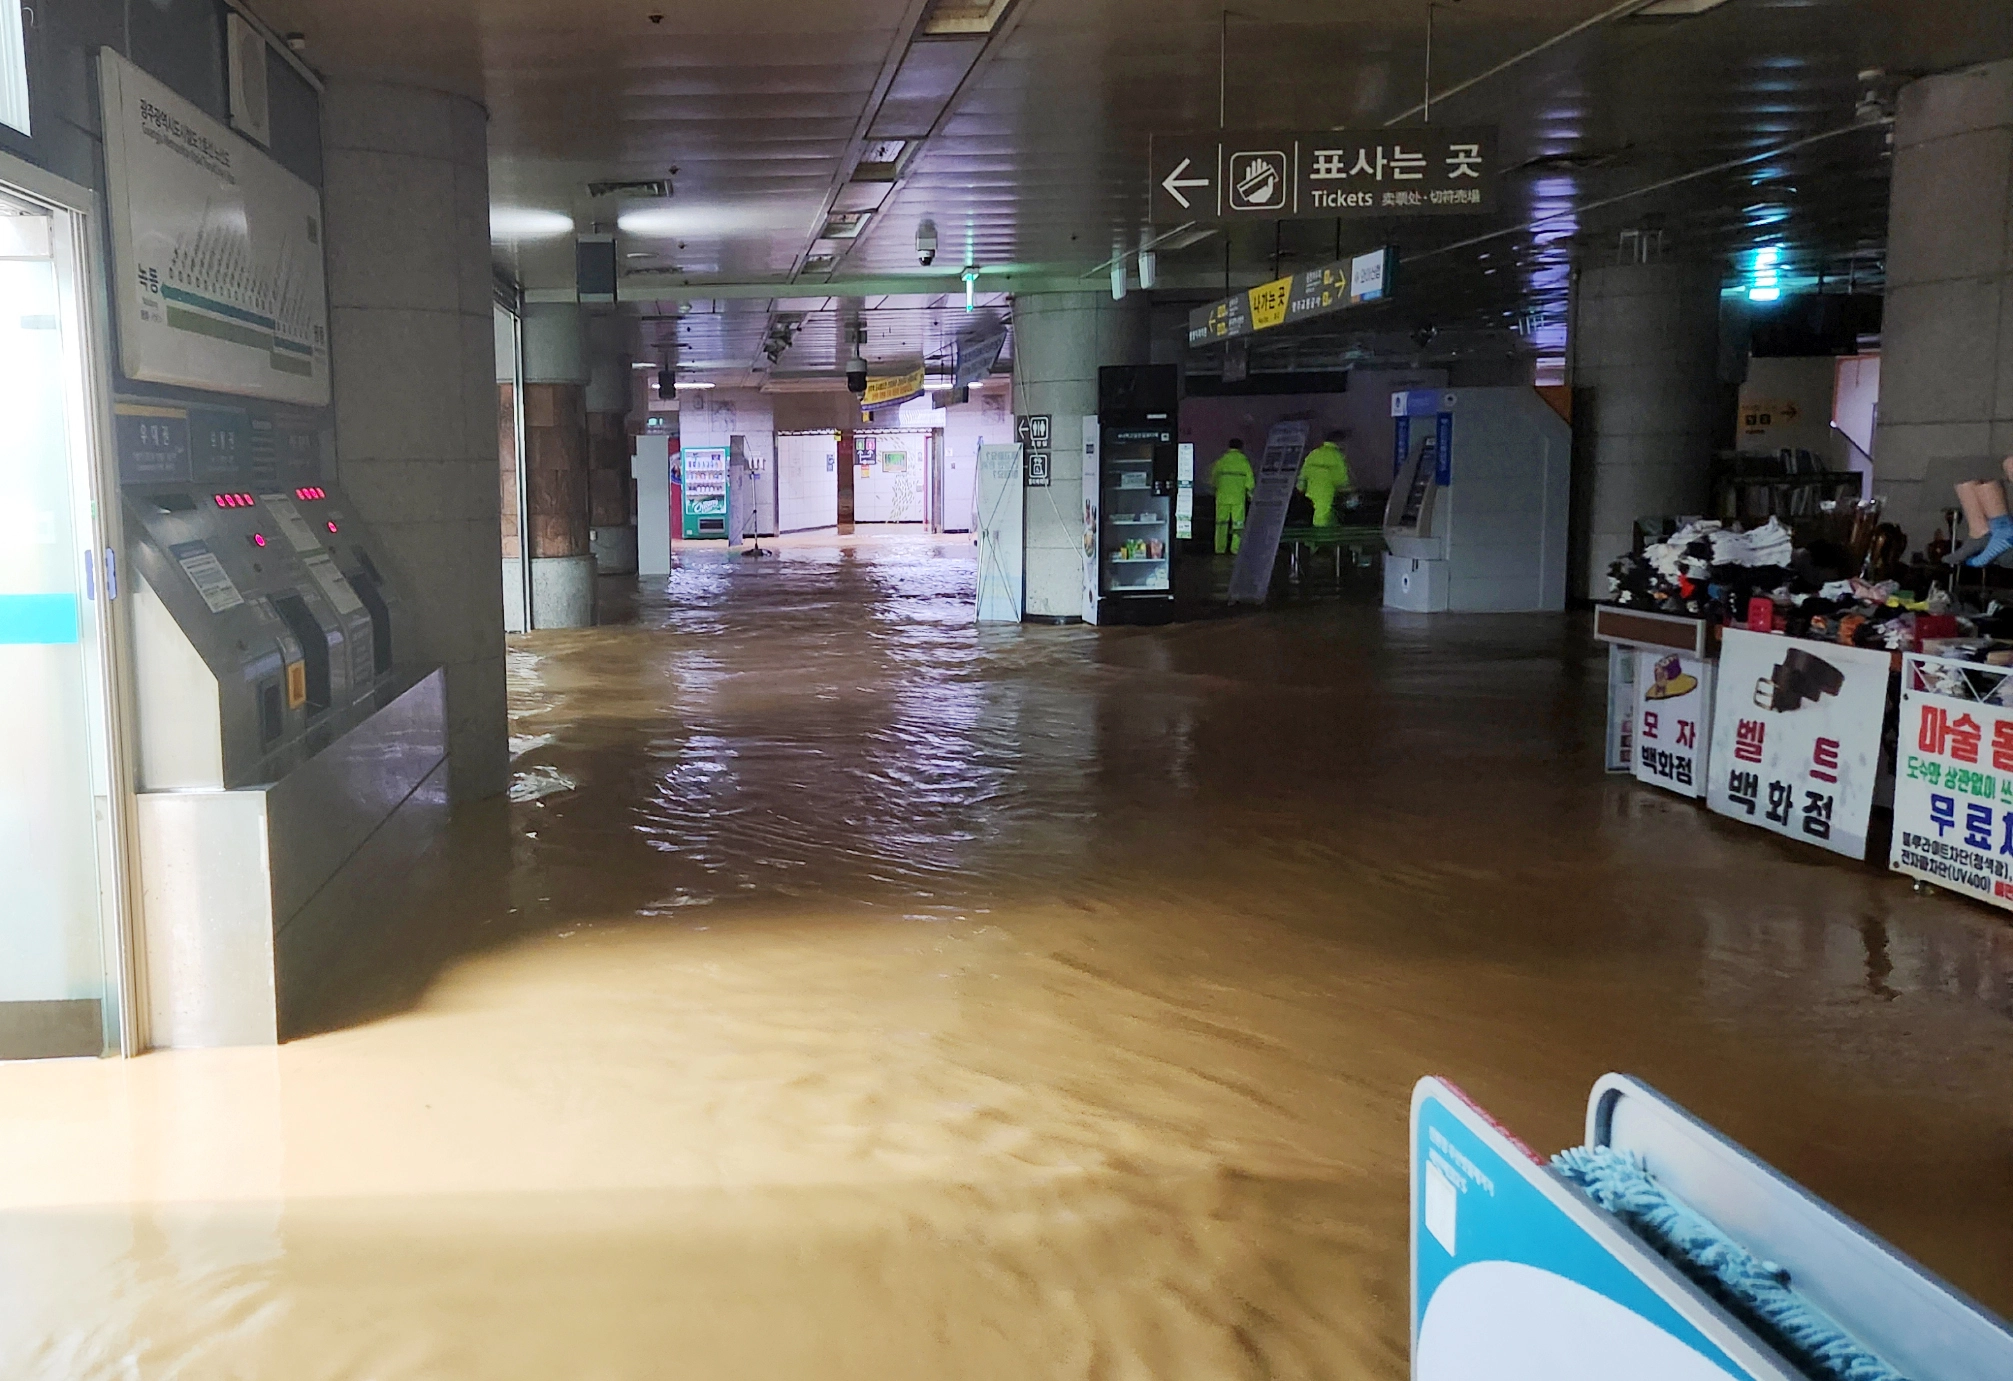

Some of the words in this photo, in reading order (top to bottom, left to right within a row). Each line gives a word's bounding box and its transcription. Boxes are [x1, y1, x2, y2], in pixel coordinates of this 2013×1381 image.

[1309, 145, 1427, 181] 표사는
[1445, 143, 1482, 179] 곳
[1310, 189, 1374, 207] Tickets
[1253, 290, 1275, 313] 나가는
[1278, 286, 1285, 307] 곳
[1643, 711, 1696, 749] 모자
[1918, 704, 1981, 764] 마술
[1642, 745, 1693, 786] 백화점
[1734, 718, 1840, 784] 벨트
[1728, 769, 1834, 841] 백화점
